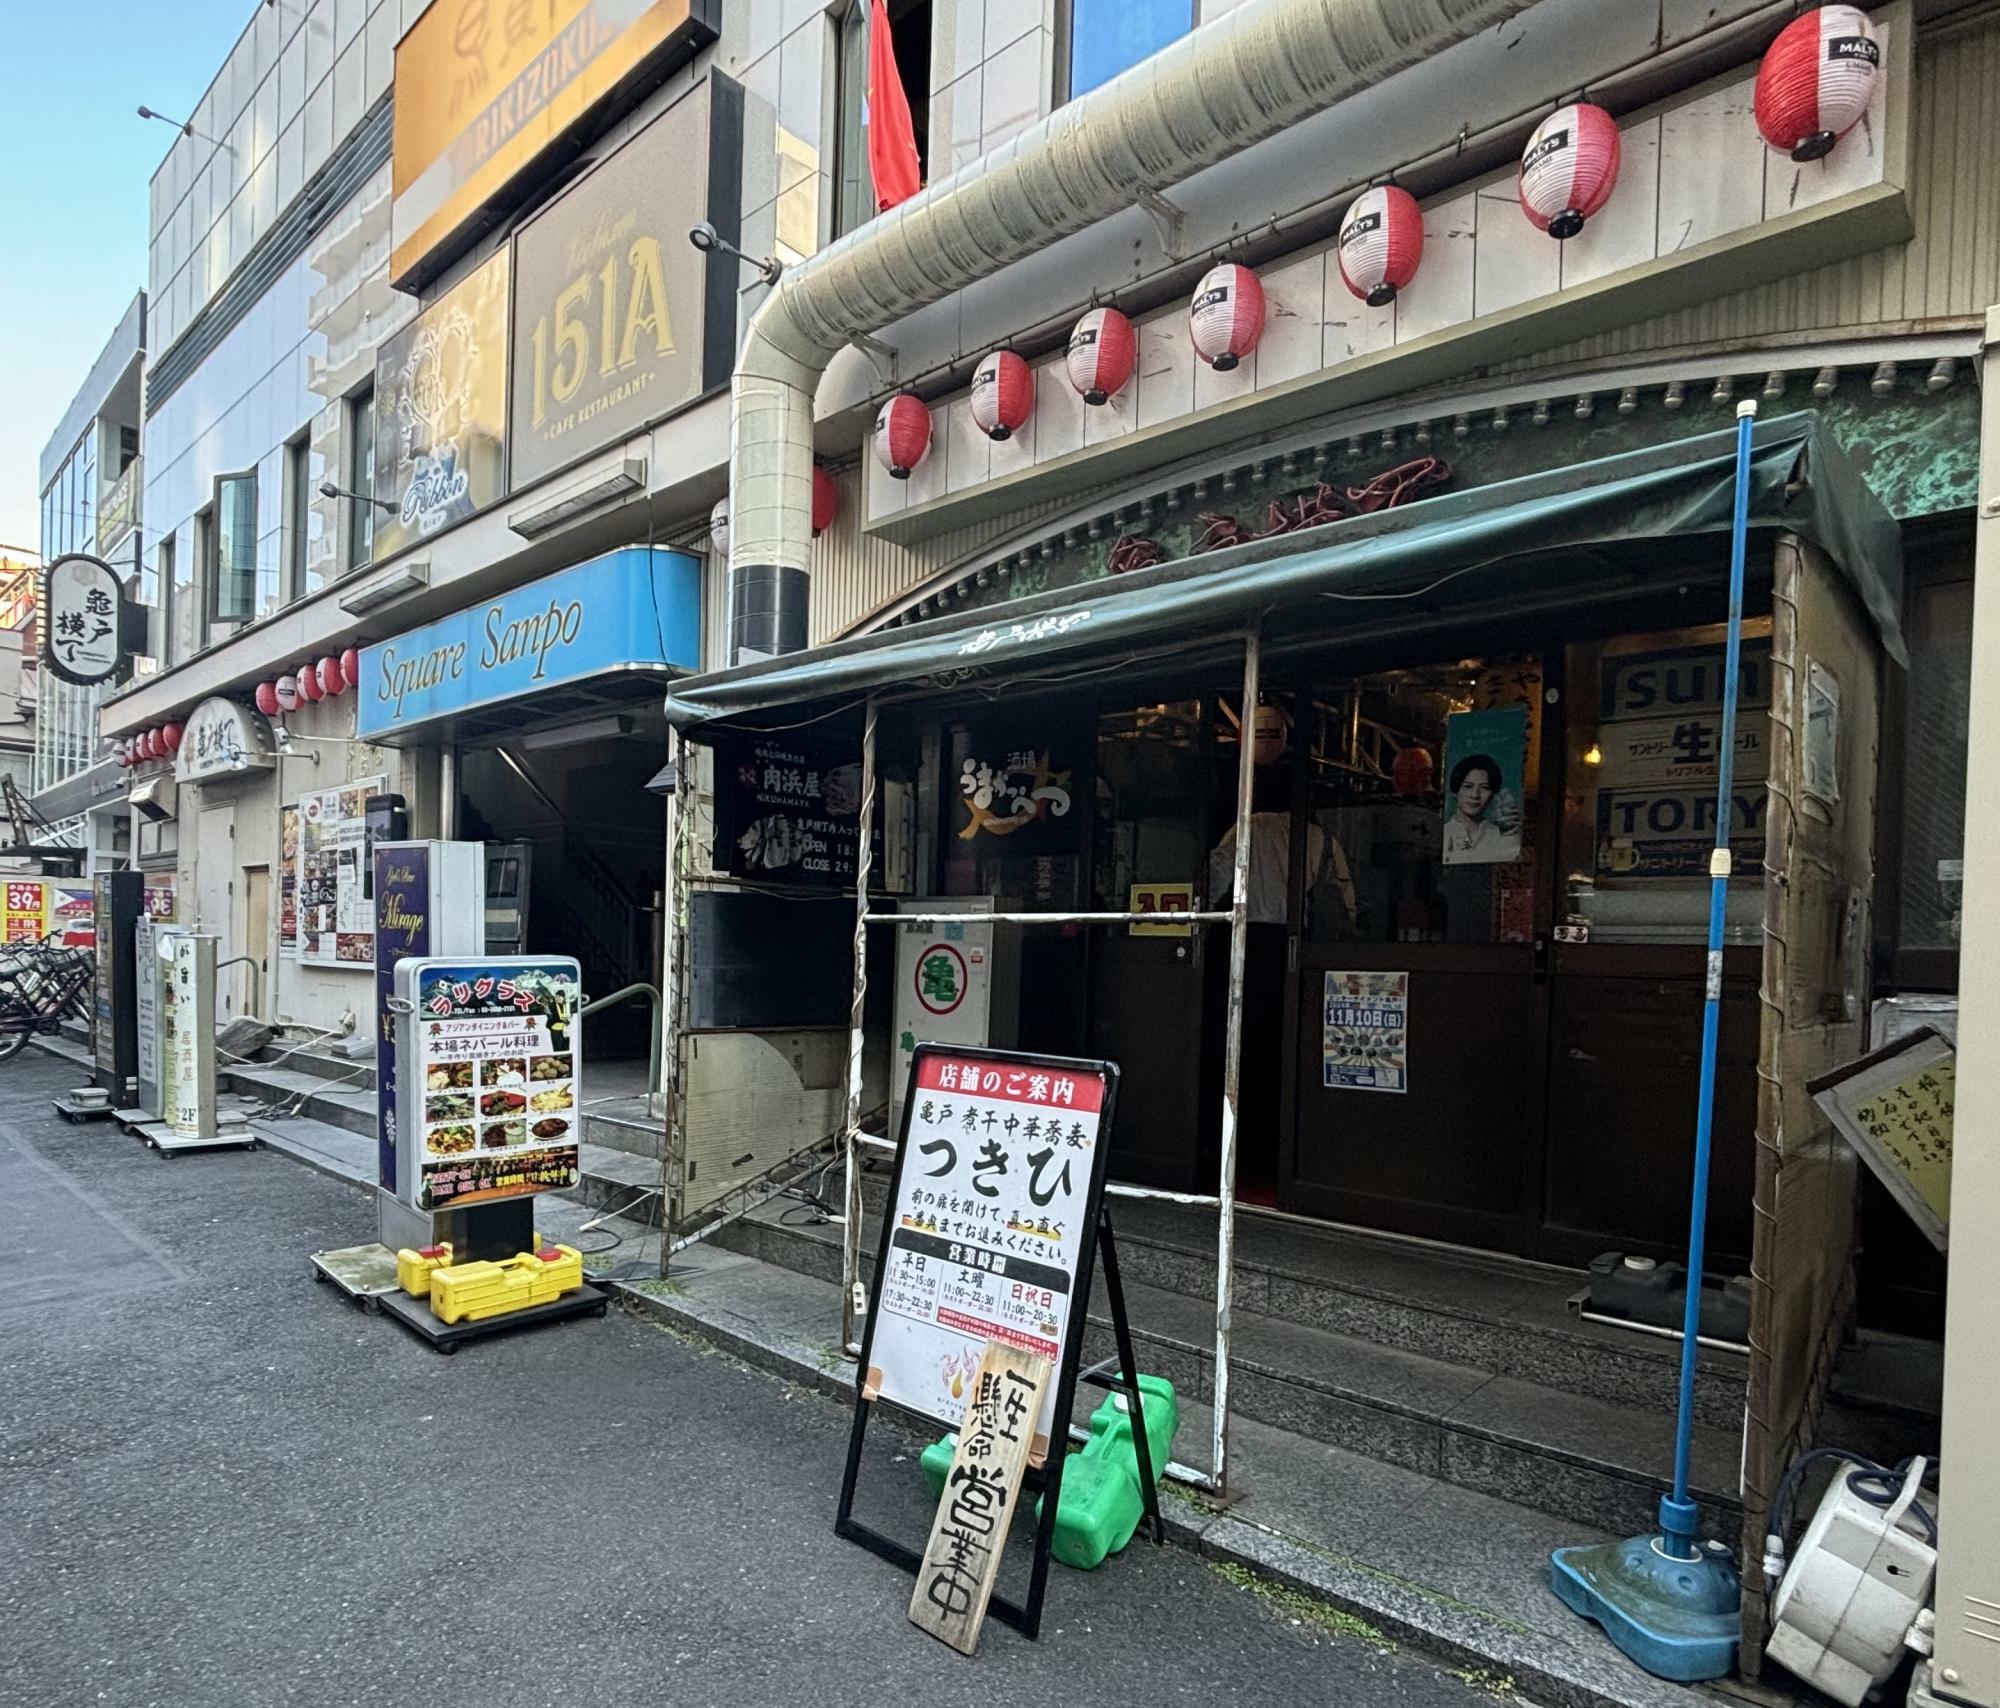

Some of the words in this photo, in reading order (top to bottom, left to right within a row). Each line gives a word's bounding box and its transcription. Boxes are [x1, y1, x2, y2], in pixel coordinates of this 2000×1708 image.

[549, 413, 574, 440] CAFE
[402, 472, 466, 523] Ribbon
[378, 640, 466, 718] Square
[480, 599, 582, 680] Sanpo
[764, 765, 822, 798] 肉浜屋
[802, 838, 827, 854] OPEN
[803, 858, 831, 872] CLOSE
[379, 890, 424, 944] Mirage
[1328, 1009, 1402, 1027] 11月10日(日)
[429, 1034, 539, 1054] 本場ネパール料理
[939, 1064, 1075, 1104] 店舗のご案内
[182, 1108, 197, 1122] 2F
[919, 1100, 954, 1125] 亀戸
[920, 1138, 1072, 1207] つきひ
[911, 1188, 1065, 1238] 前の扉を開けて、真っ直ぐ
[902, 1212, 1068, 1266] 一番奥までお進みください。
[949, 1244, 1007, 1274] 営業時間
[902, 1252, 927, 1273] 平日
[958, 1267, 985, 1289] 土曜
[1011, 1284, 1054, 1310] 日祝日
[1000, 1369, 1037, 1442] 一生
[928, 1463, 1007, 1621] 営業中
